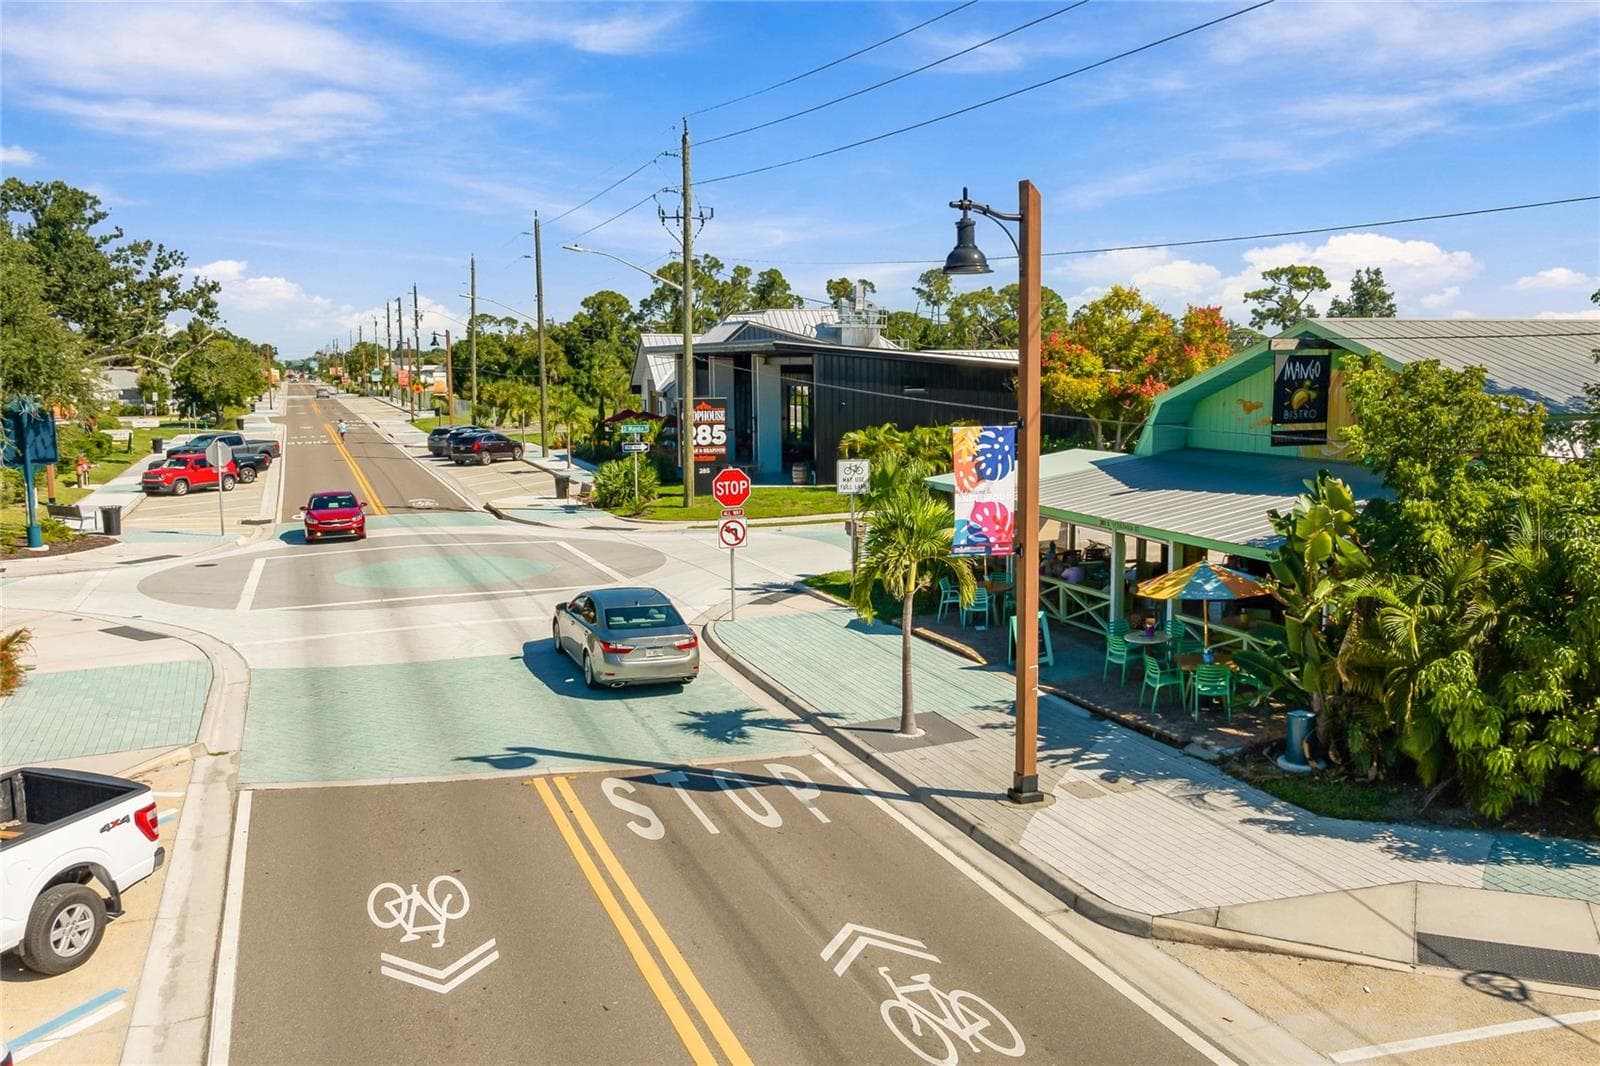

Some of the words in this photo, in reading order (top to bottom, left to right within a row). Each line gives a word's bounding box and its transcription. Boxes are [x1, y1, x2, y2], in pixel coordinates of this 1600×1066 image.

[1284, 360, 1321, 380] MANGO
[1283, 409, 1318, 420] BISTRO
[716, 480, 748, 496] STOP
[600, 763, 831, 841] STOP
